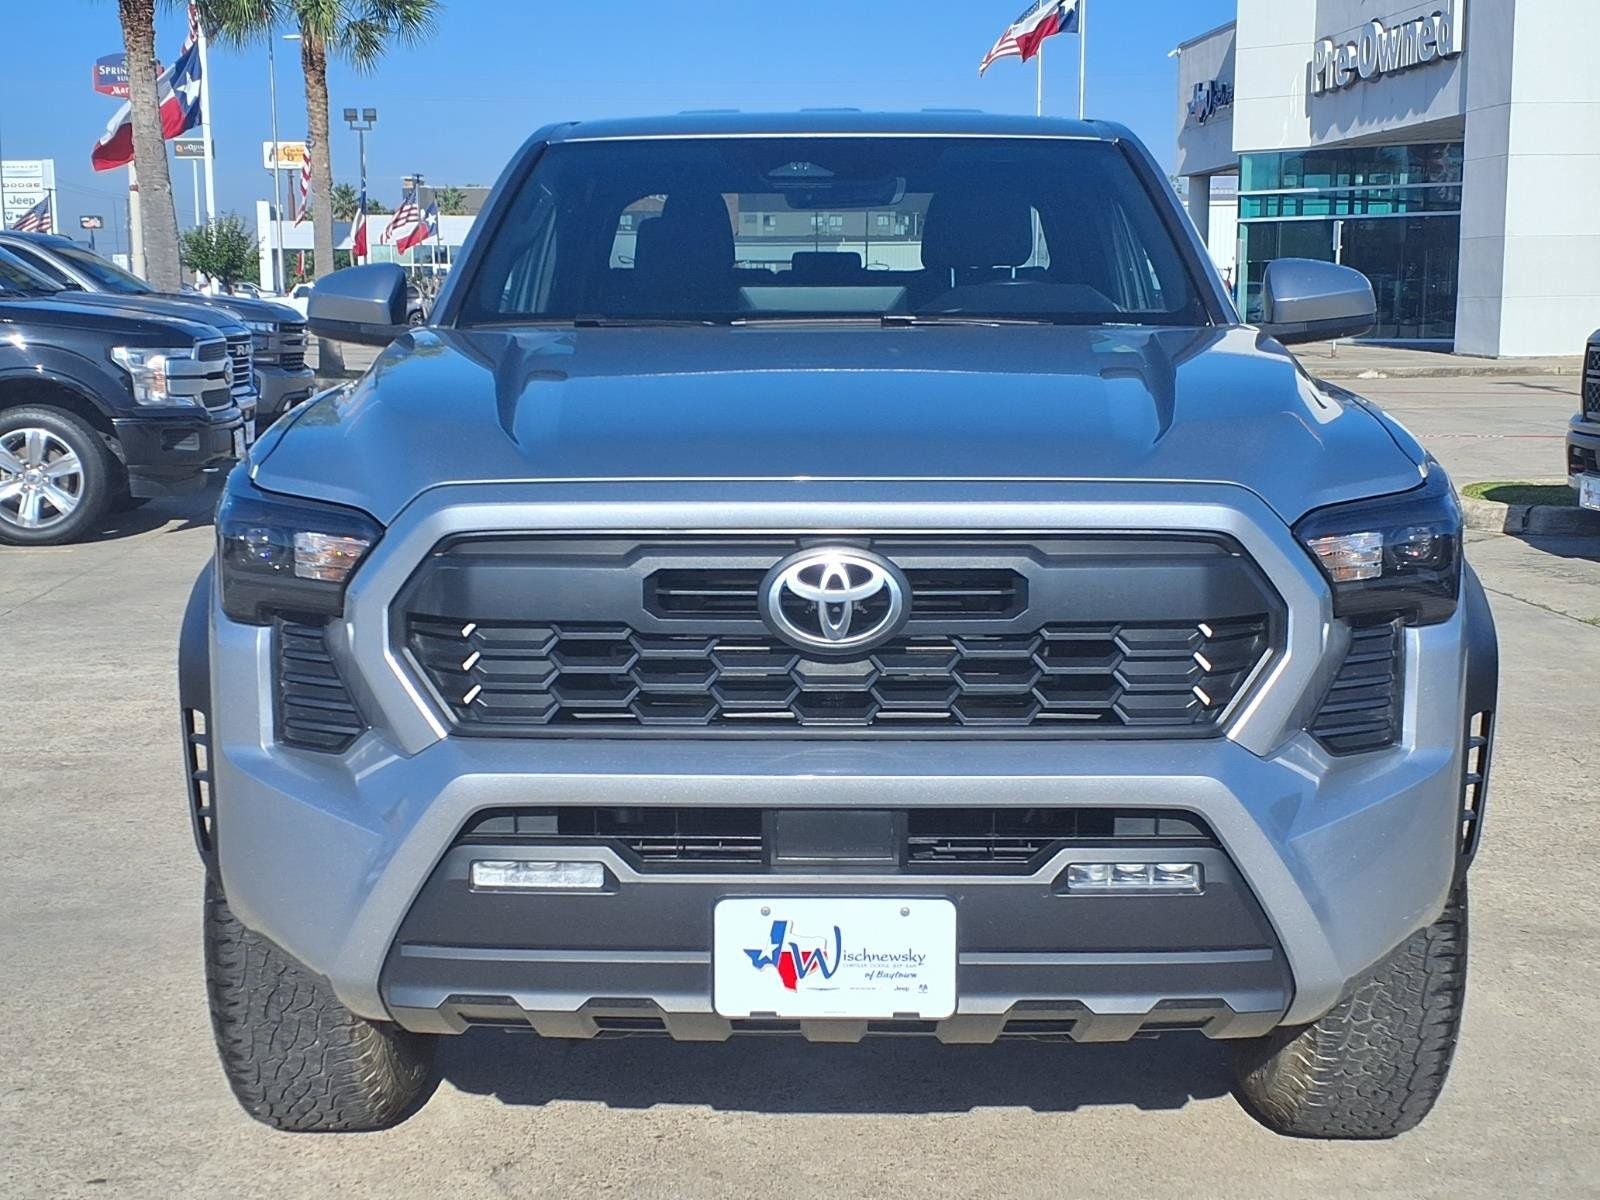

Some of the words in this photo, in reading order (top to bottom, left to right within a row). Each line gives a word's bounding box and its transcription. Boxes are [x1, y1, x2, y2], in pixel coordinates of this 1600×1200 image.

[1311, 1, 1462, 93] Pre-Owned
[99, 65, 128, 75] SPRIN
[9, 195, 36, 206] Jeep
